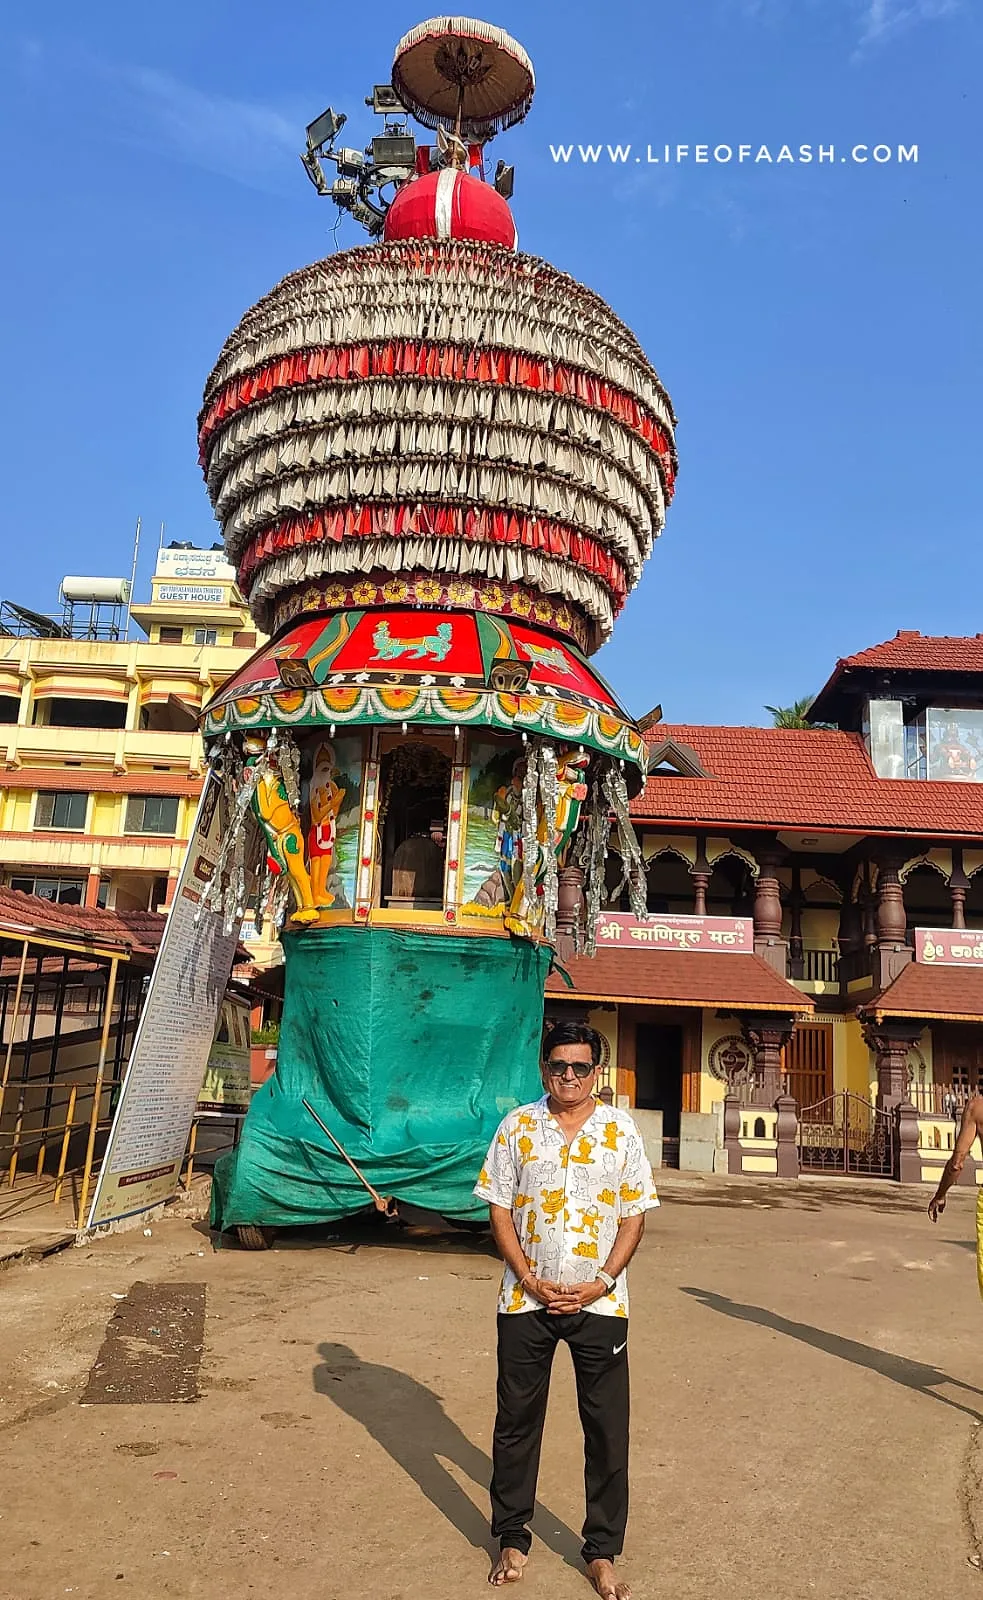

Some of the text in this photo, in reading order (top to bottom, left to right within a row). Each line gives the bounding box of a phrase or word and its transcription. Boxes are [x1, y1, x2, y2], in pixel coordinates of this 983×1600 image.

[175, 567, 216, 576] ಭವನ
[160, 593, 189, 601] GUEST
[599, 921, 624, 941] श्री
